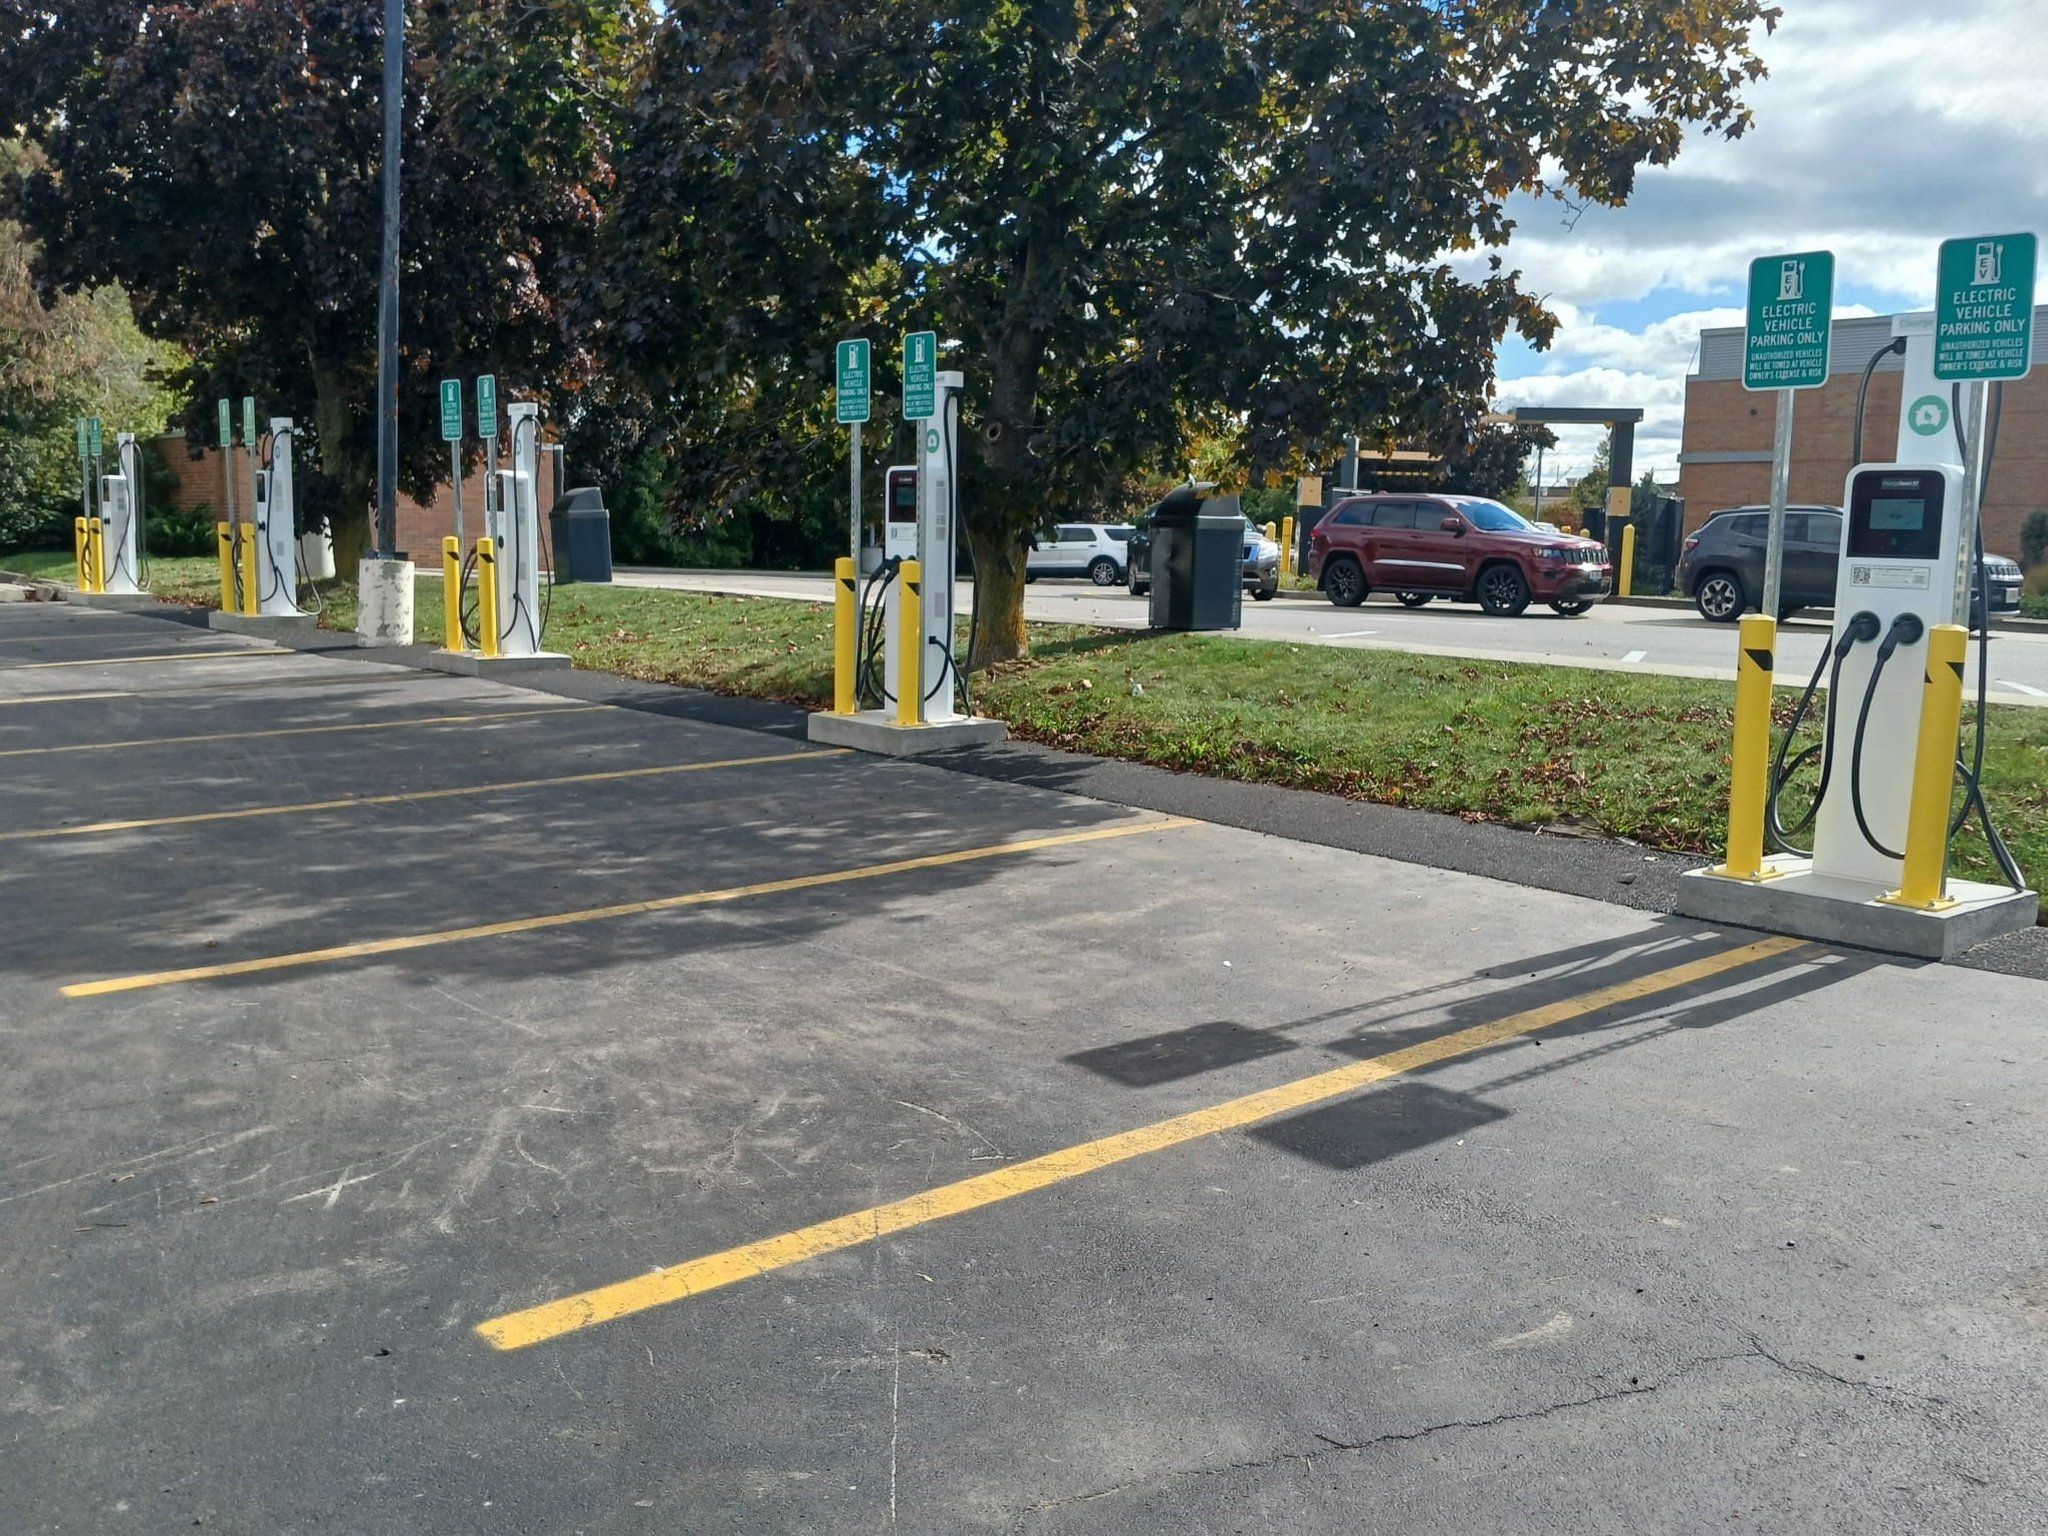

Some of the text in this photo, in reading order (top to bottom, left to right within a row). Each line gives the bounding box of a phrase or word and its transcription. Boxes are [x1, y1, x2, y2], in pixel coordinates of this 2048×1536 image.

[1980, 257, 1988, 279] EV
[1784, 274, 1792, 294] EV
[1953, 287, 2016, 304] ELECTRIC
[1762, 302, 1816, 318] ELECTRIC
[1956, 304, 2012, 319] VEHICLE
[1764, 317, 1812, 332] VEHICLE
[1940, 318, 2026, 336] PARKING ONLY
[1751, 331, 1824, 348] PARKING ONLY
[1992, 337, 2024, 348] VEHICLES
[1795, 348, 1822, 359] VEHICLES
[1997, 347, 2024, 358] VEHICLE
[1799, 357, 1822, 367] VEHICLE
[2007, 358, 2023, 368] RISK
[1808, 367, 1822, 377] RISK
